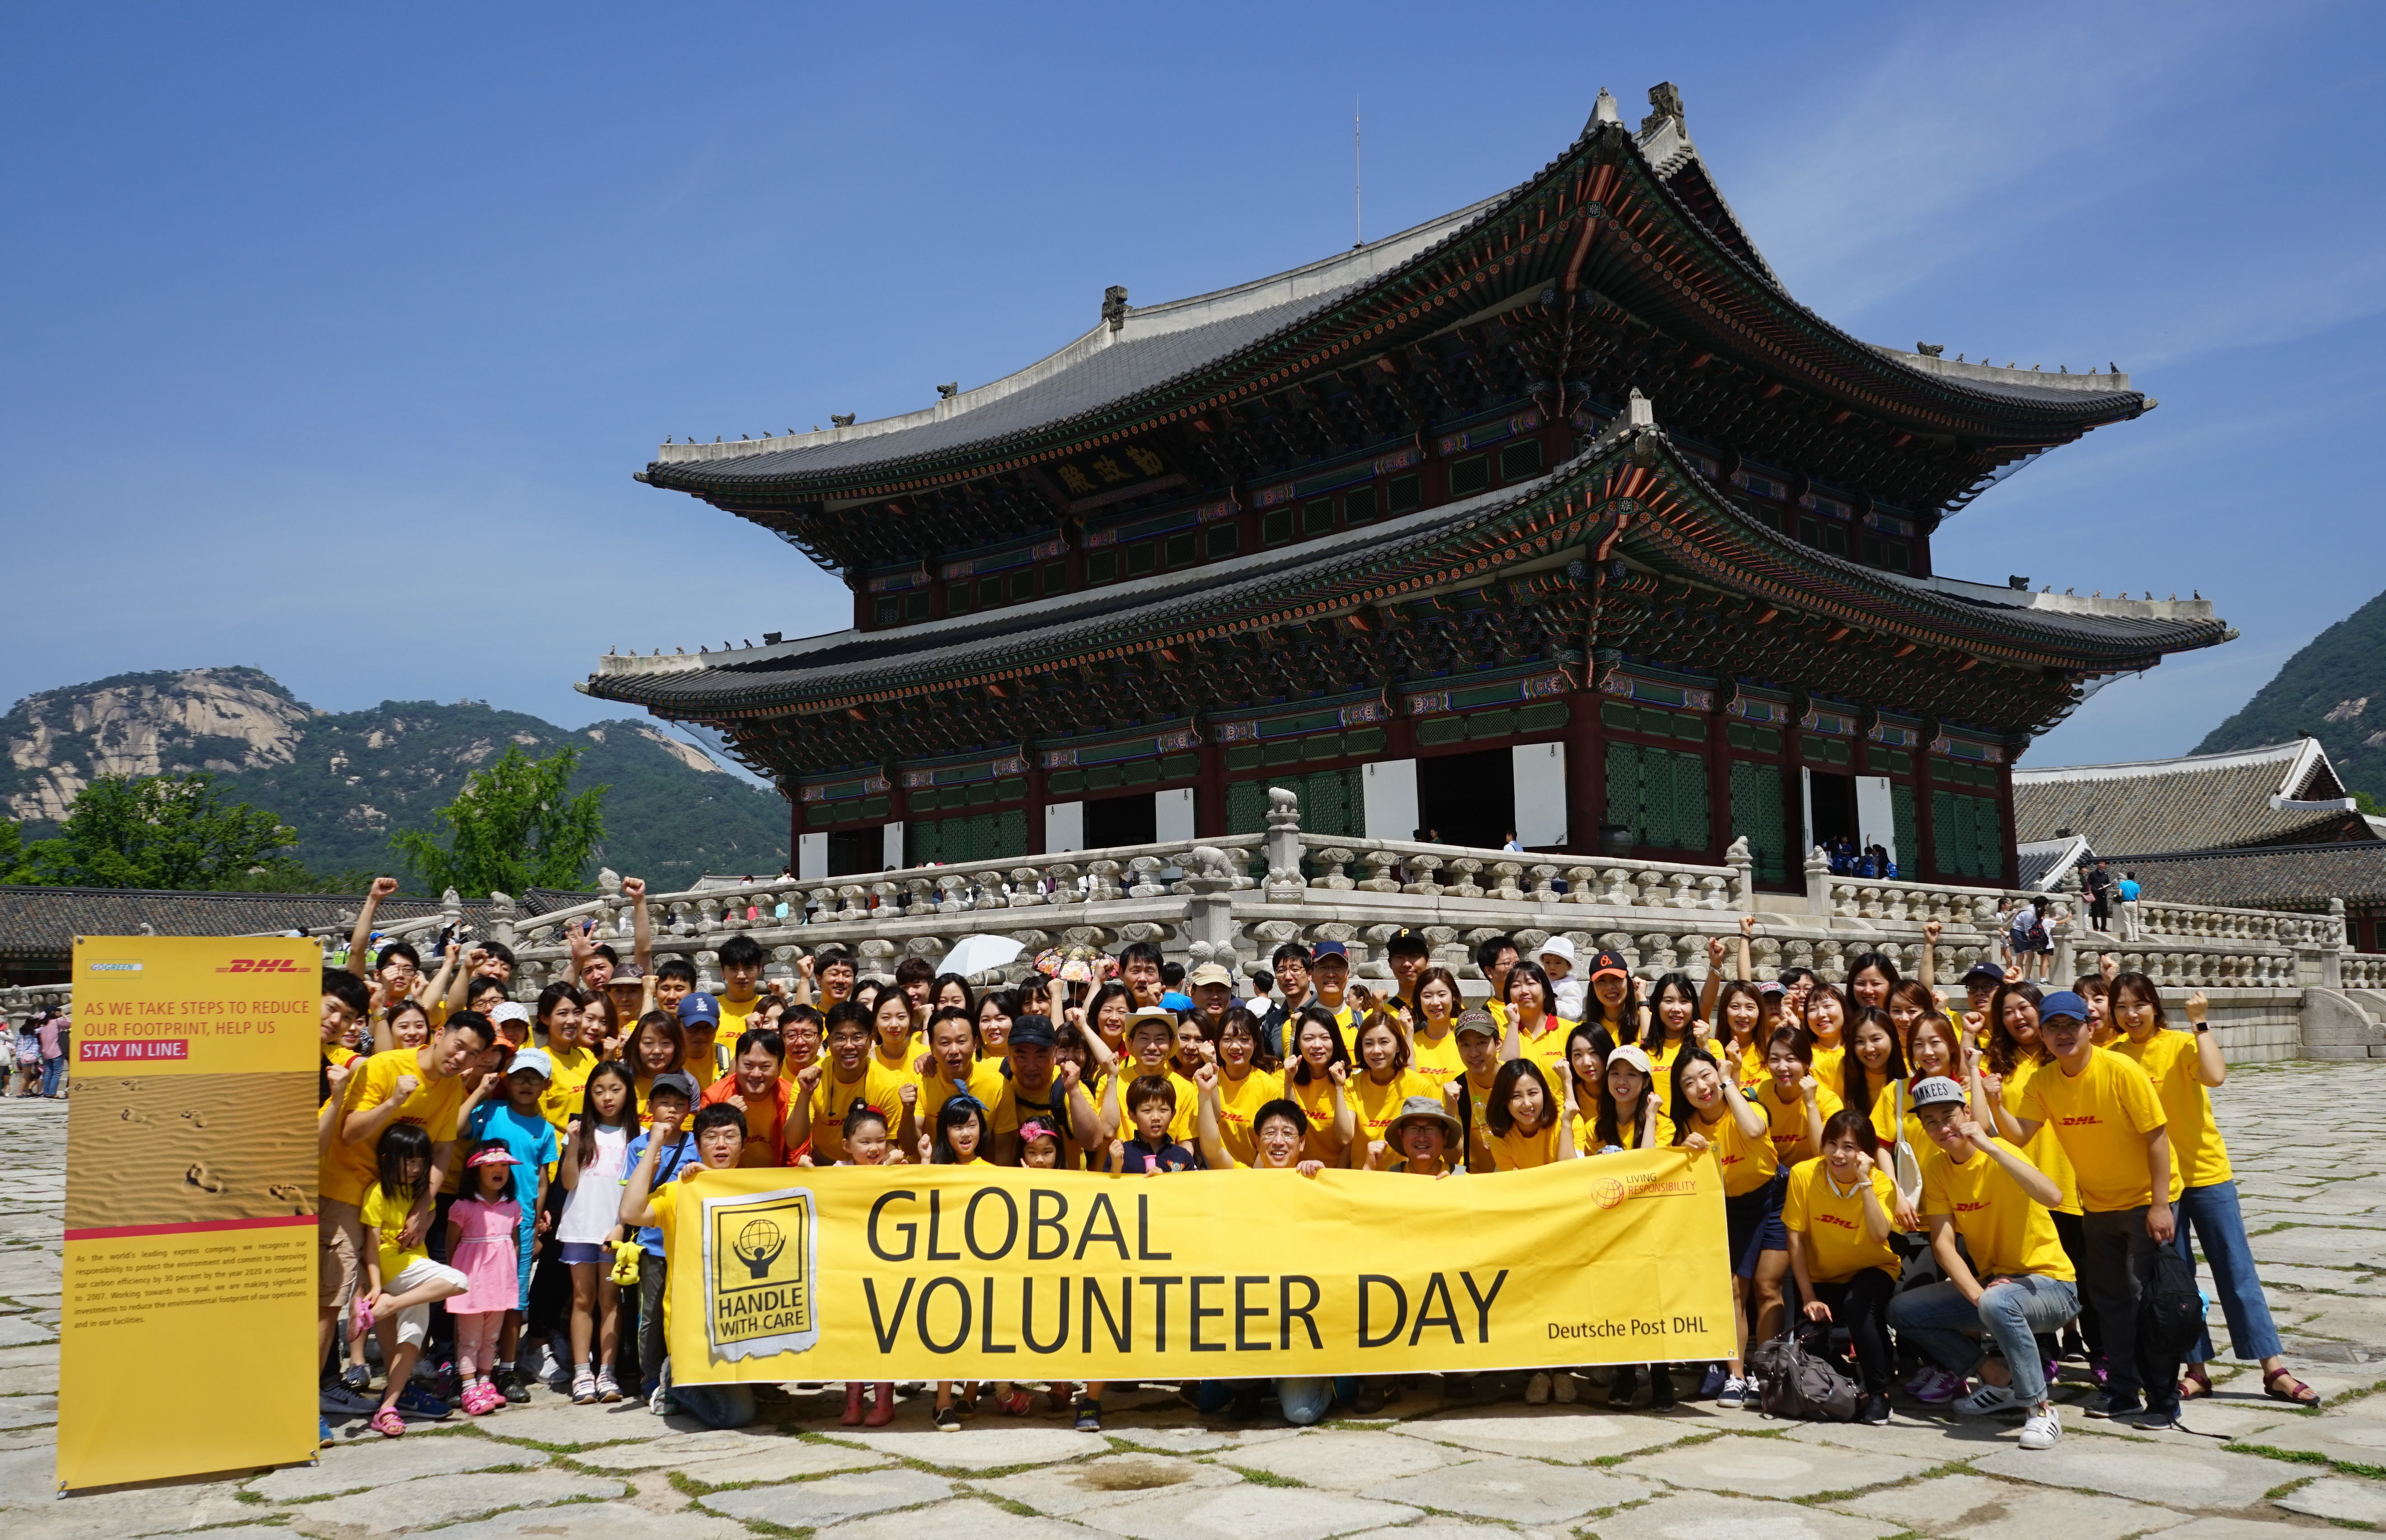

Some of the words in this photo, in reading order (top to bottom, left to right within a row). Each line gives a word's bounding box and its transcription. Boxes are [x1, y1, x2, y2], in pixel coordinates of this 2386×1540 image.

[1401, 928, 1410, 937] P
[229, 960, 298, 972] DHL
[84, 1002, 104, 1015] AS
[109, 1002, 133, 1015] WE
[137, 1002, 175, 1015] TAKE
[181, 1002, 224, 1014] STEPS
[228, 1002, 246, 1014] TO
[253, 1001, 309, 1014] REDUCE
[84, 1023, 117, 1036] OUR
[124, 1022, 209, 1036] FOOTPRINT,
[216, 1021, 251, 1034] HELP
[257, 1021, 275, 1034] US
[83, 1044, 121, 1058] STAY
[126, 1043, 142, 1057] IN
[148, 1043, 186, 1056] LINE.
[1221, 1110, 1244, 1122] DHL
[2063, 1116, 2097, 1126] DHL
[1771, 1134, 1802, 1143] DHL
[1626, 1173, 1657, 1183] LIVING
[1628, 1180, 1696, 1195] RESPONSIBILITY
[867, 1186, 1172, 1262] GLOBAL
[1820, 1214, 1855, 1229] DHL
[109, 1251, 136, 1259] world's
[258, 1241, 290, 1250] recognize
[75, 1266, 124, 1276] responsibility
[136, 1264, 160, 1272] protect
[177, 1259, 220, 1268] environment
[117, 1277, 151, 1285] efficiency
[176, 1273, 202, 1282] percent
[274, 1265, 307, 1273] compared
[87, 1293, 108, 1301] 2007.
[145, 1288, 173, 1296] towards
[194, 1285, 211, 1294] goal,
[272, 1278, 307, 1287] significant
[74, 1306, 117, 1315] investments
[168, 1297, 217, 1307] environmental
[219, 1295, 249, 1303] footprint
[272, 1291, 307, 1299] operations
[719, 1287, 803, 1319] HANDLE
[863, 1276, 1323, 1353] VOLUNTEER
[1358, 1269, 1509, 1348] DAY
[113, 1317, 145, 1325] facilities.
[720, 1317, 757, 1337] WITH
[764, 1310, 804, 1329] CARE
[1548, 1319, 1626, 1339] Deutsche
[1631, 1319, 1666, 1335] Post
[1673, 1316, 1708, 1334] DHL
